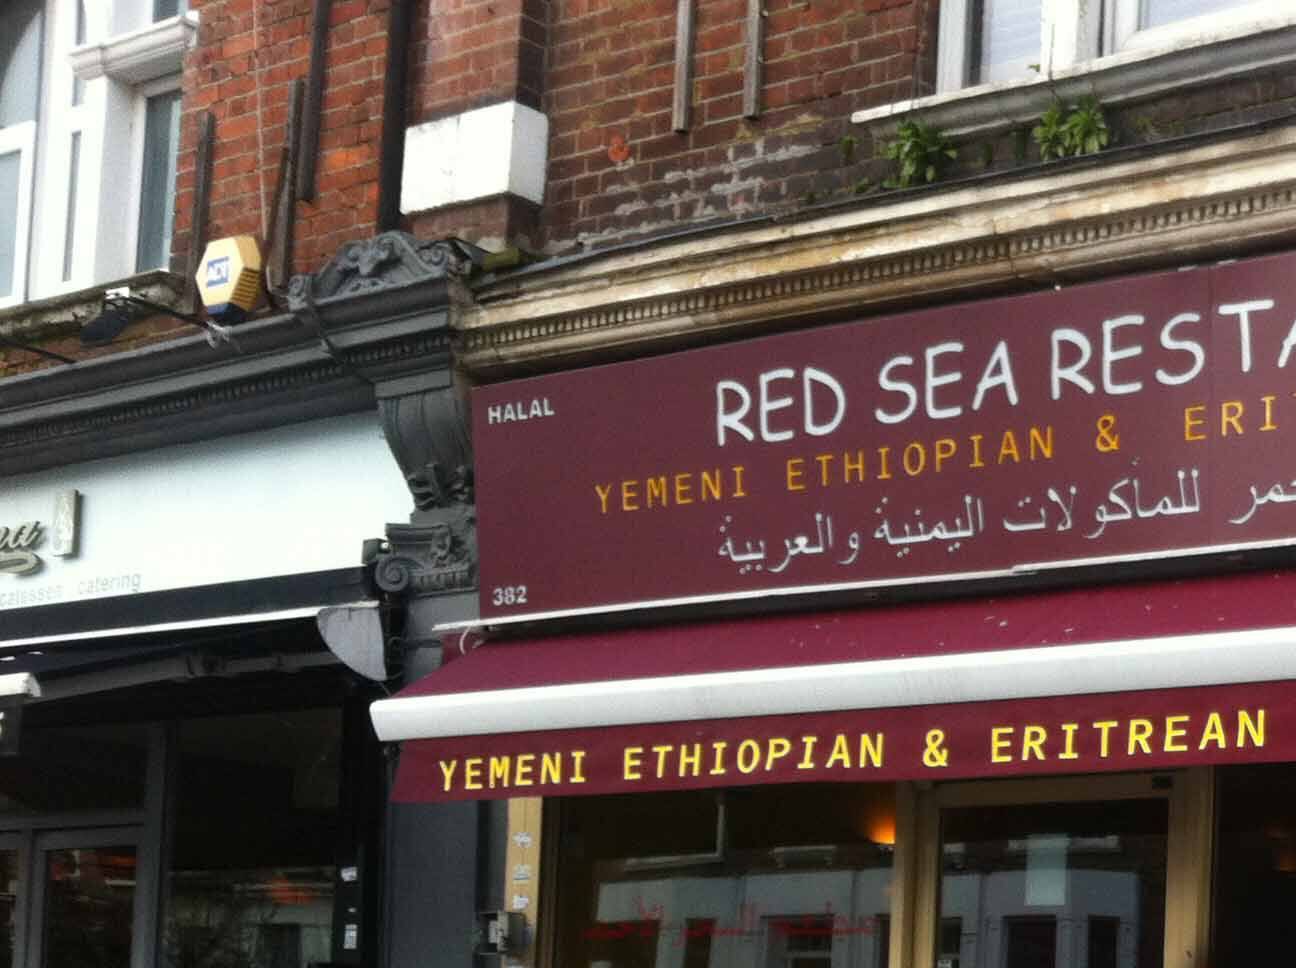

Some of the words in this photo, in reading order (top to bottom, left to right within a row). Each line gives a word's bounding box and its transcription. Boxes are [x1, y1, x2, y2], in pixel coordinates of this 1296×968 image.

[487, 398, 555, 425] HALAL
[715, 366, 847, 446] RED
[875, 341, 1018, 424] SEA
[595, 466, 748, 514] YEMENI
[786, 425, 1054, 492] ETHIOPIAN
[1095, 414, 1121, 453] &
[873, 495, 984, 558] اليمنية
[79, 573, 142, 594] catering
[492, 586, 528, 607] 382
[439, 749, 588, 792] YEMENI
[622, 732, 885, 782] ETHIOPIAN
[922, 728, 949, 769] &
[990, 709, 1266, 763] ERITREAN
